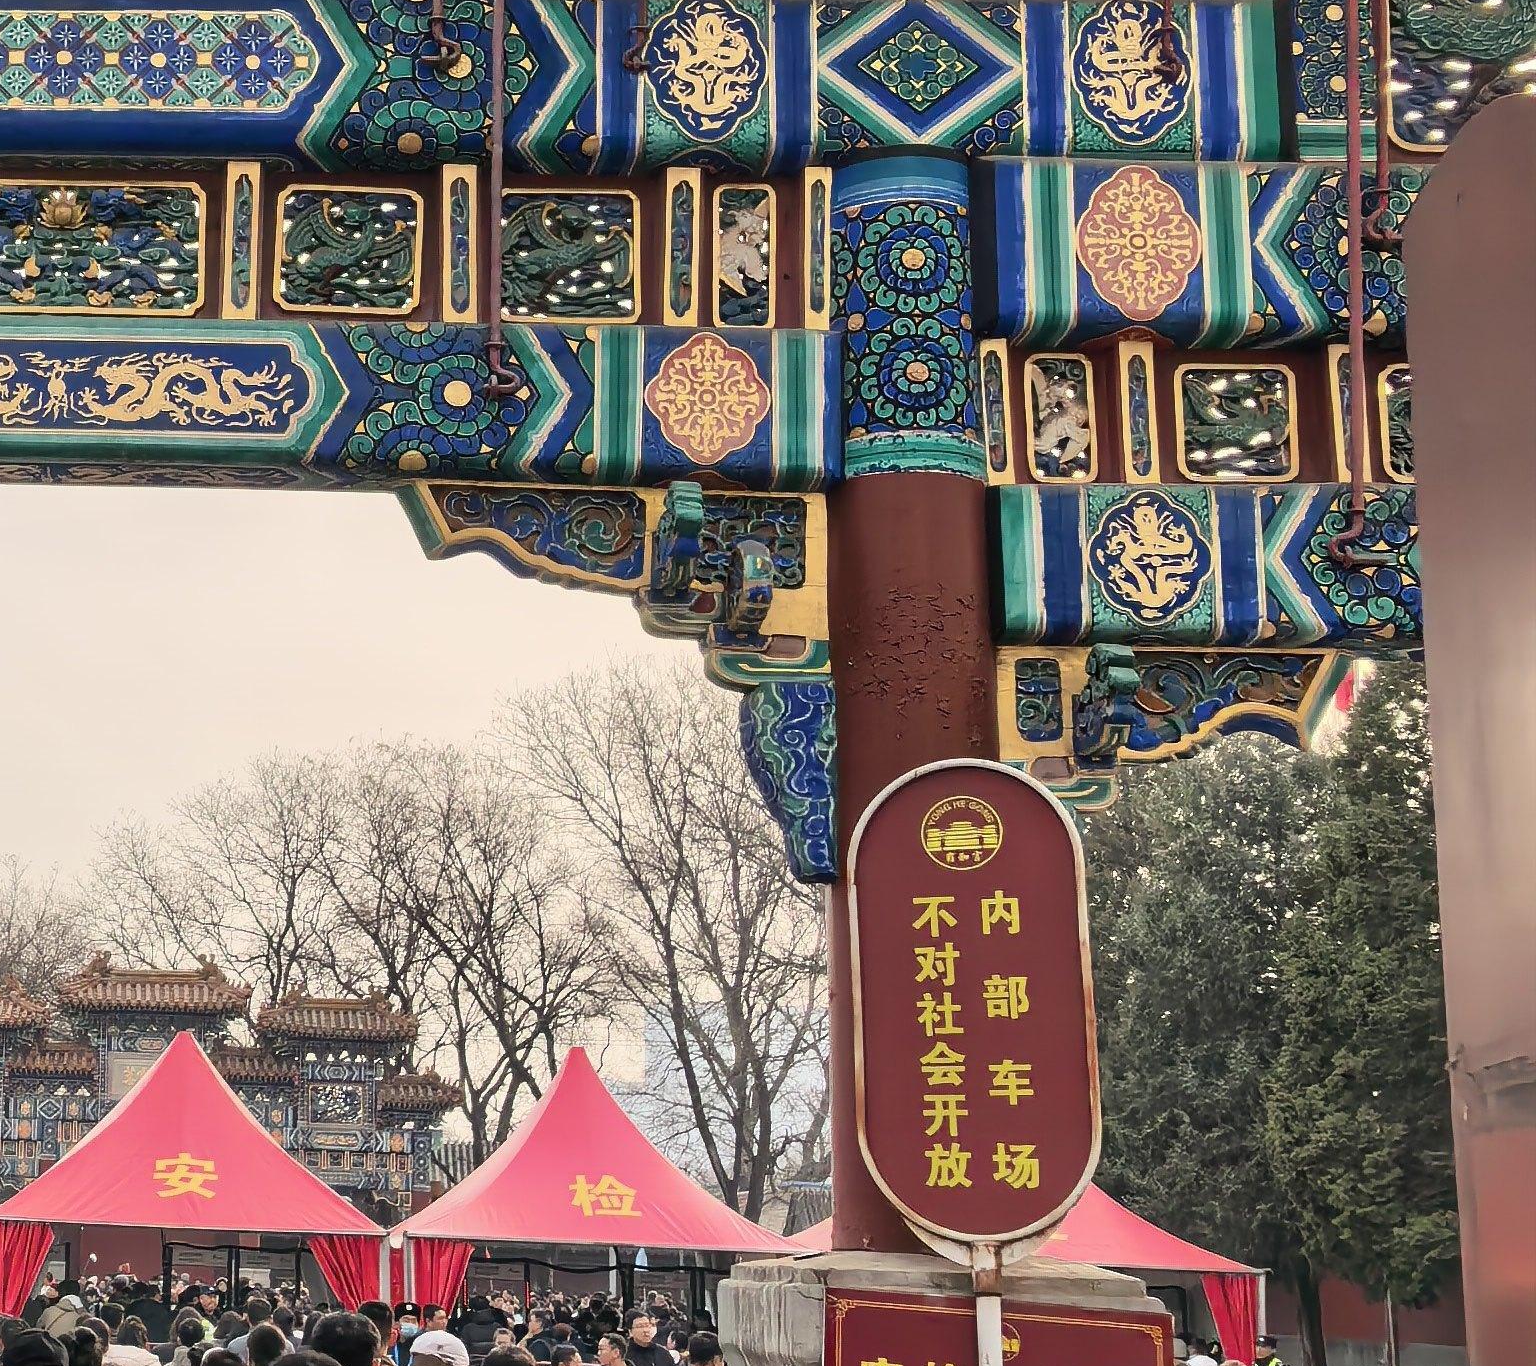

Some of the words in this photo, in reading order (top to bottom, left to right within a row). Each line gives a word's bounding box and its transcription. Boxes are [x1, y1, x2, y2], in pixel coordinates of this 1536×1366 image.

[911, 895, 973, 1189] 不对社会开放
[980, 890, 1040, 1190] 内部车场
[152, 1152, 220, 1199] 安
[568, 1173, 643, 1218] 检
